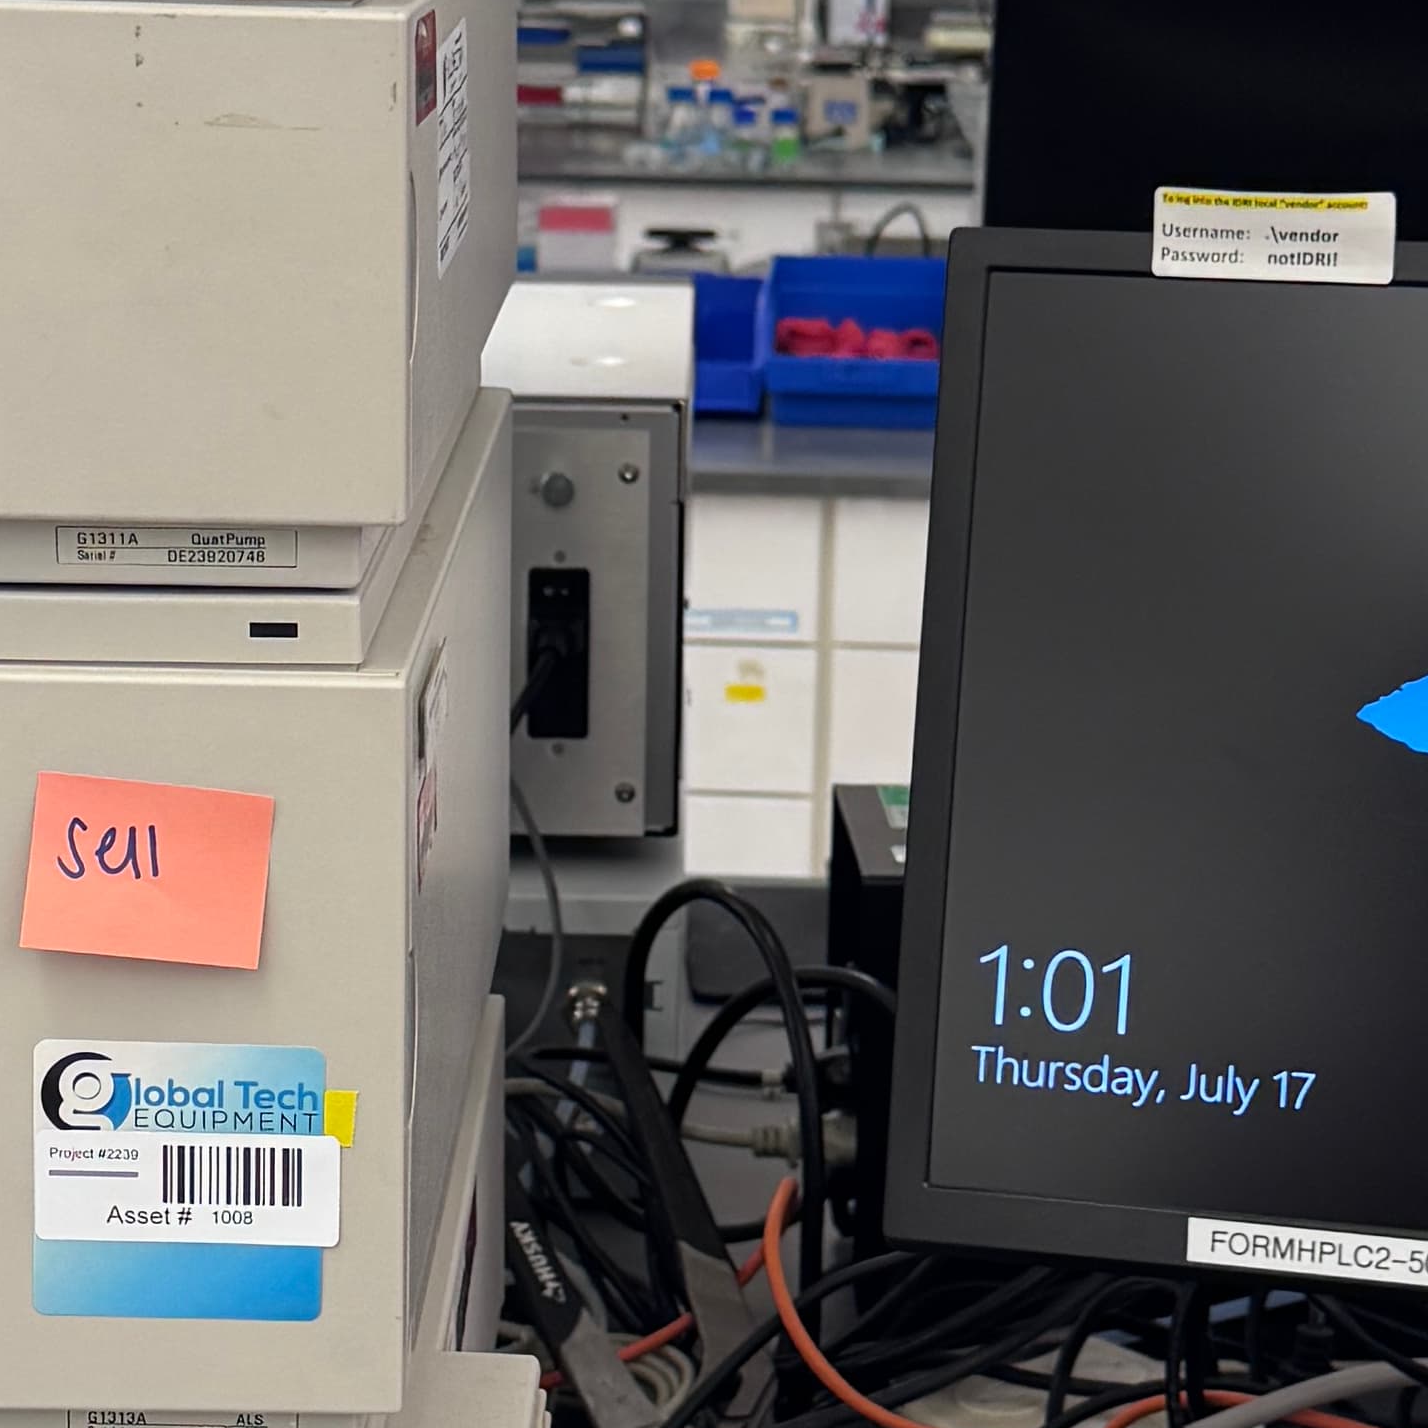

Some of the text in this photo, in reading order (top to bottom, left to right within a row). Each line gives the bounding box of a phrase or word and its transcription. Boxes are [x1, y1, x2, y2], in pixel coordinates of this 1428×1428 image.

[1161, 222, 1251, 242] Username:
[1161, 246, 1245, 265] Password:
[77, 532, 138, 546] G1311A
[78, 550, 106, 561] Serial
[979, 944, 1131, 1036] 1:01
[971, 1045, 1317, 1116] Thursday, July 17
[233, 1079, 319, 1112] Tech
[133, 1108, 321, 1134] EQUIPMENT
[49, 1146, 93, 1162] Project
[106, 1204, 254, 1225] Asset # 1008
[87, 1412, 264, 1426] G1313A ALS
